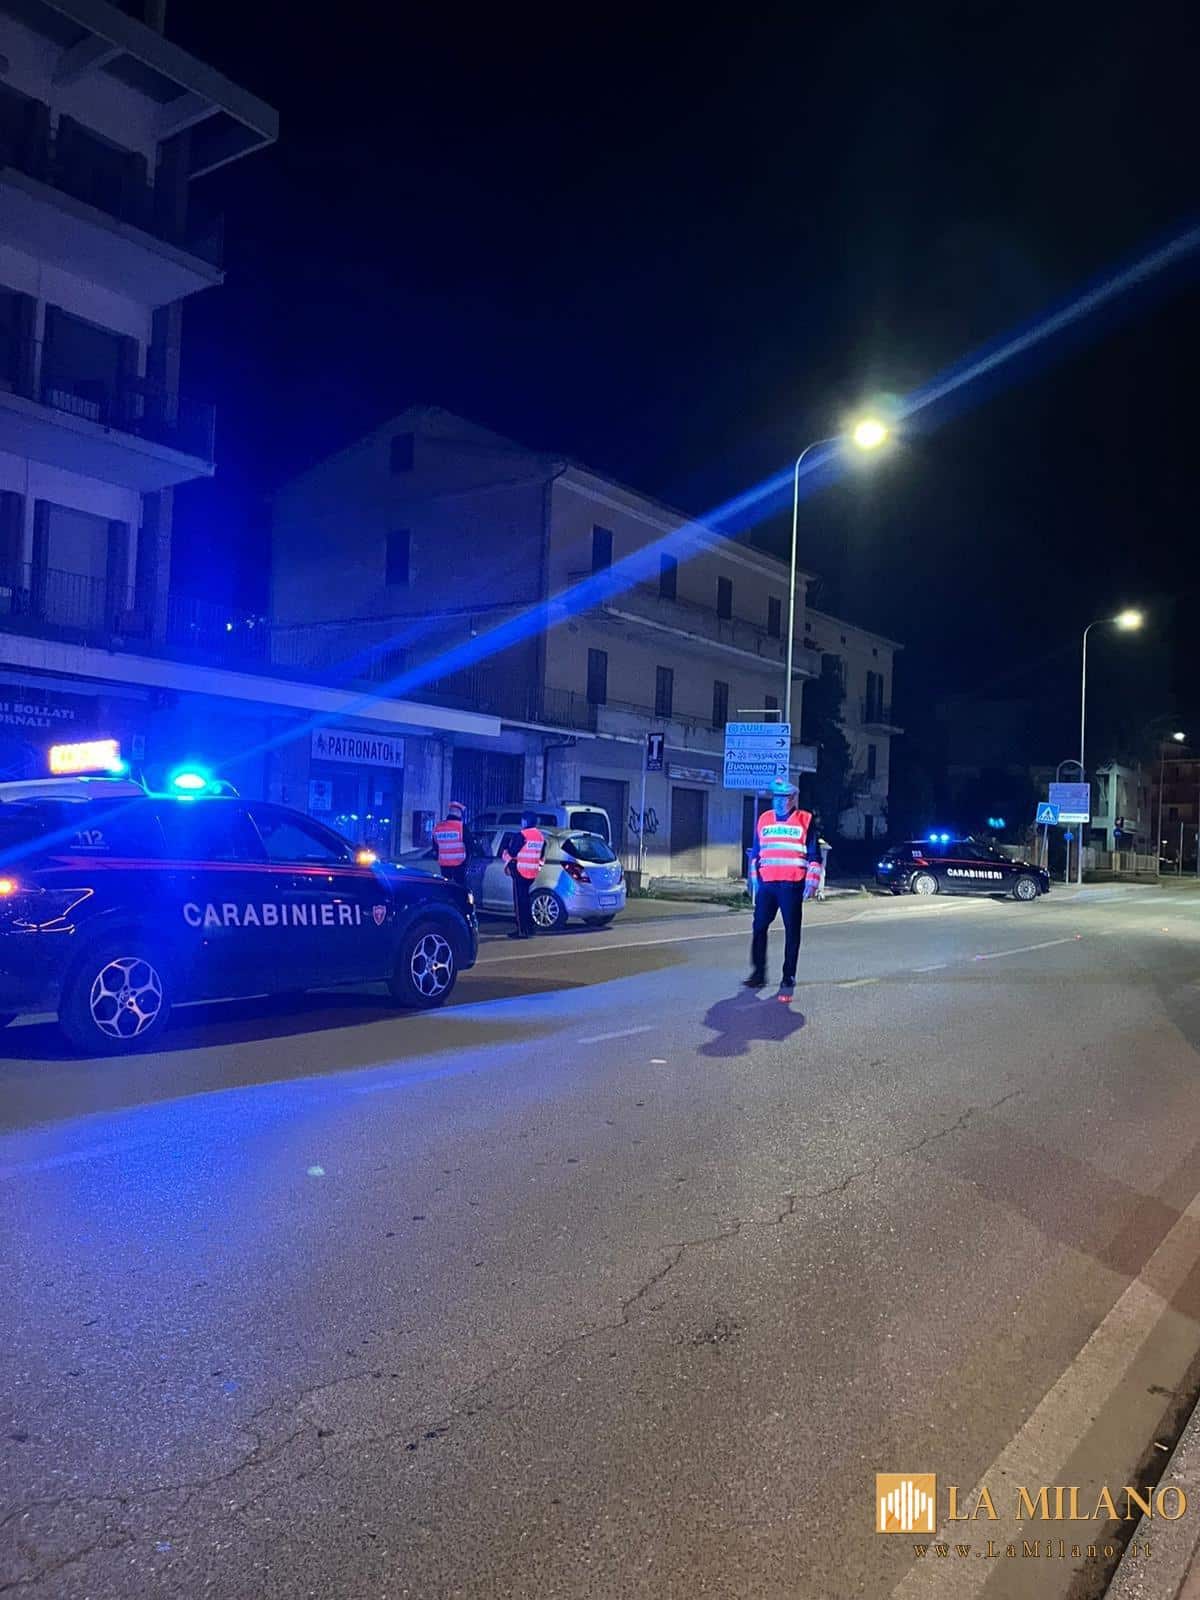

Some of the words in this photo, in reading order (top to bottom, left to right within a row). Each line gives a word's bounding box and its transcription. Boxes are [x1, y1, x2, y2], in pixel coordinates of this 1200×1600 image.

[14, 703, 75, 719] BOLLATI
[328, 736, 389, 760] PATRONATO
[947, 868, 1003, 880] CARABINIERI
[183, 902, 361, 926] CARABINIERI
